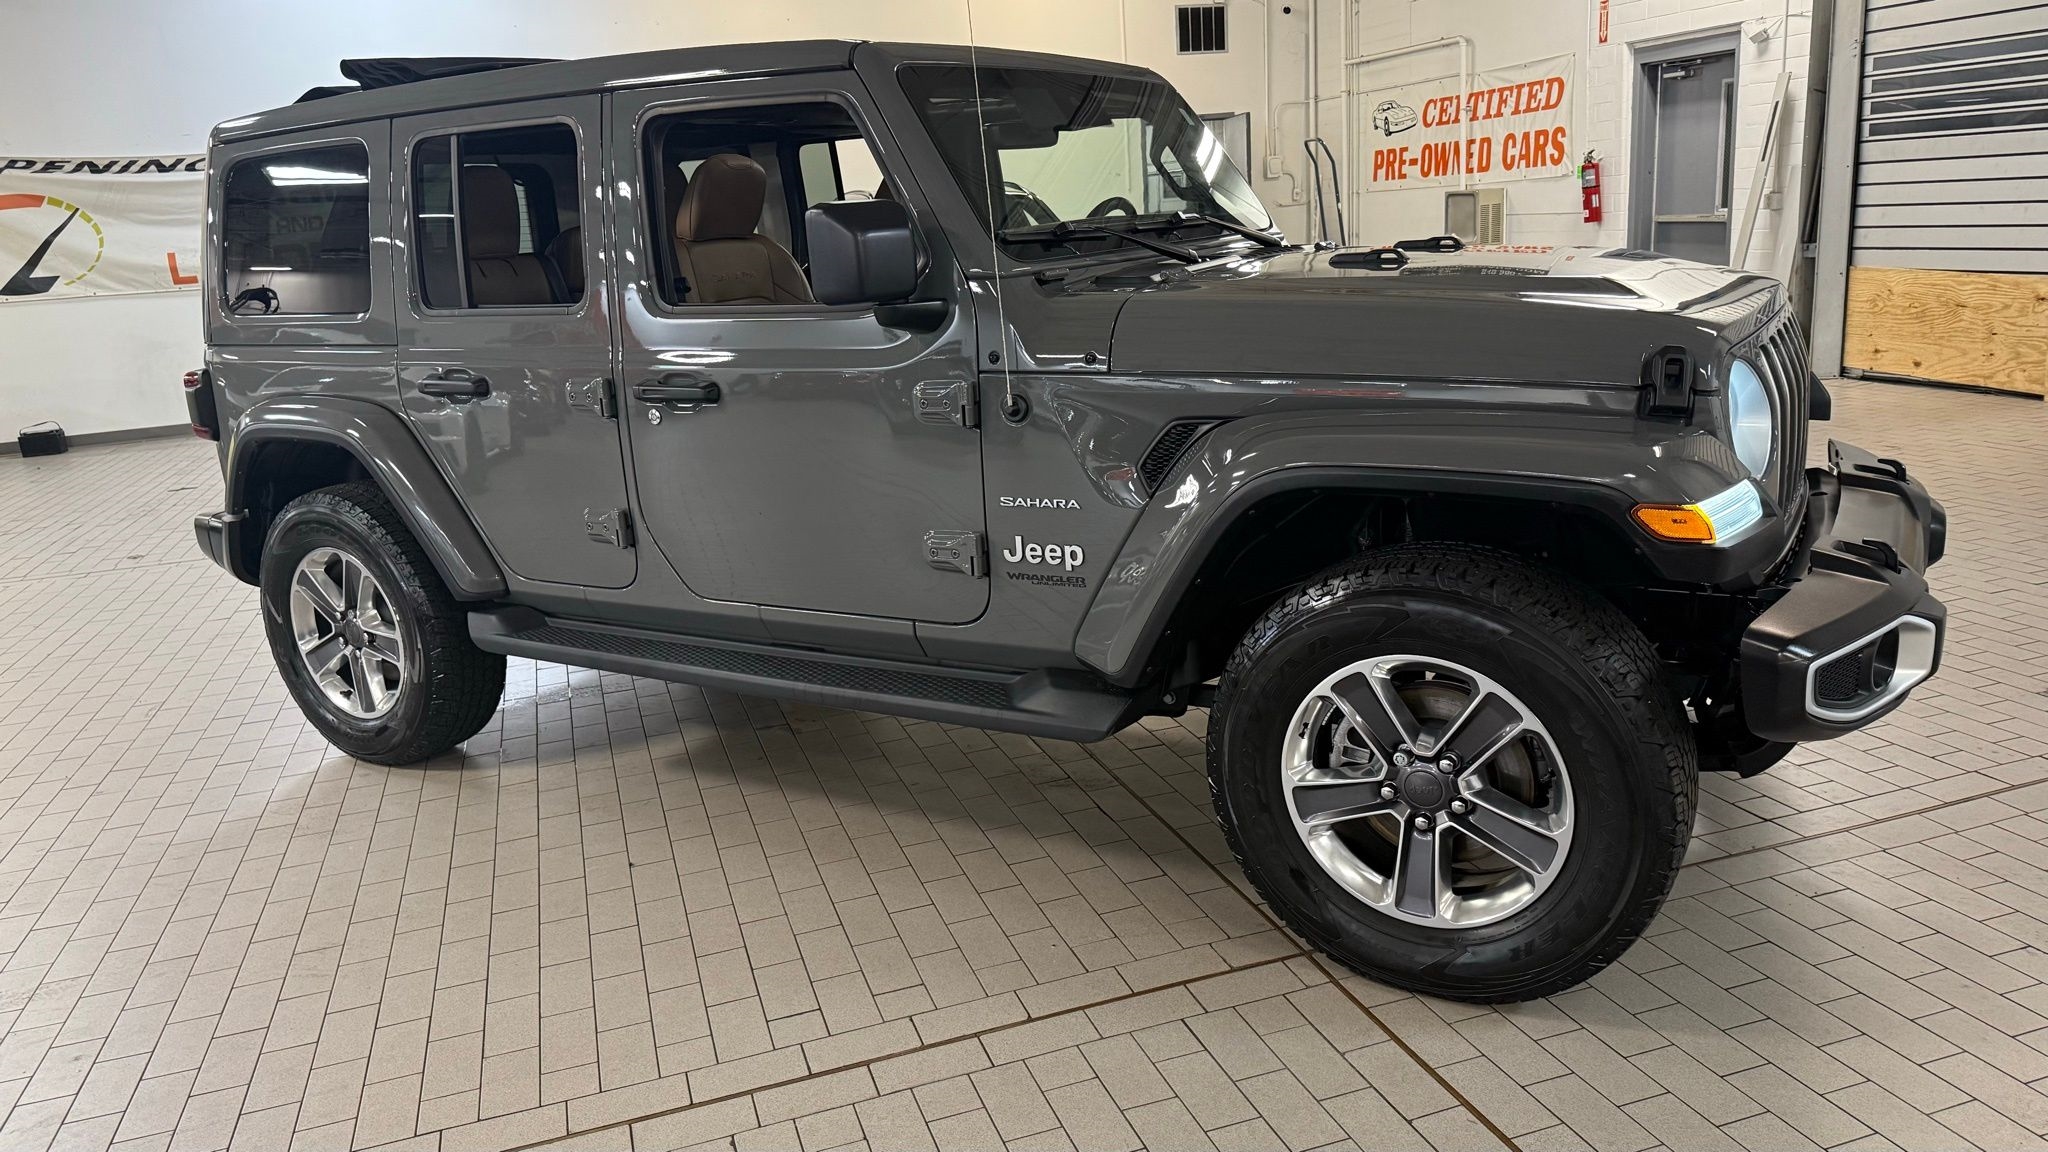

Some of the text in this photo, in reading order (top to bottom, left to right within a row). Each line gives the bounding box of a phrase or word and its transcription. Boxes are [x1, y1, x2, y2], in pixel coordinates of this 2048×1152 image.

[1501, 126, 1566, 171] CARS
[1000, 496, 1080, 509] SAHARA
[1003, 535, 1084, 571] Jeep
[1006, 571, 1086, 584] WRANGLER
[1031, 580, 1087, 588] UNLIMITED
